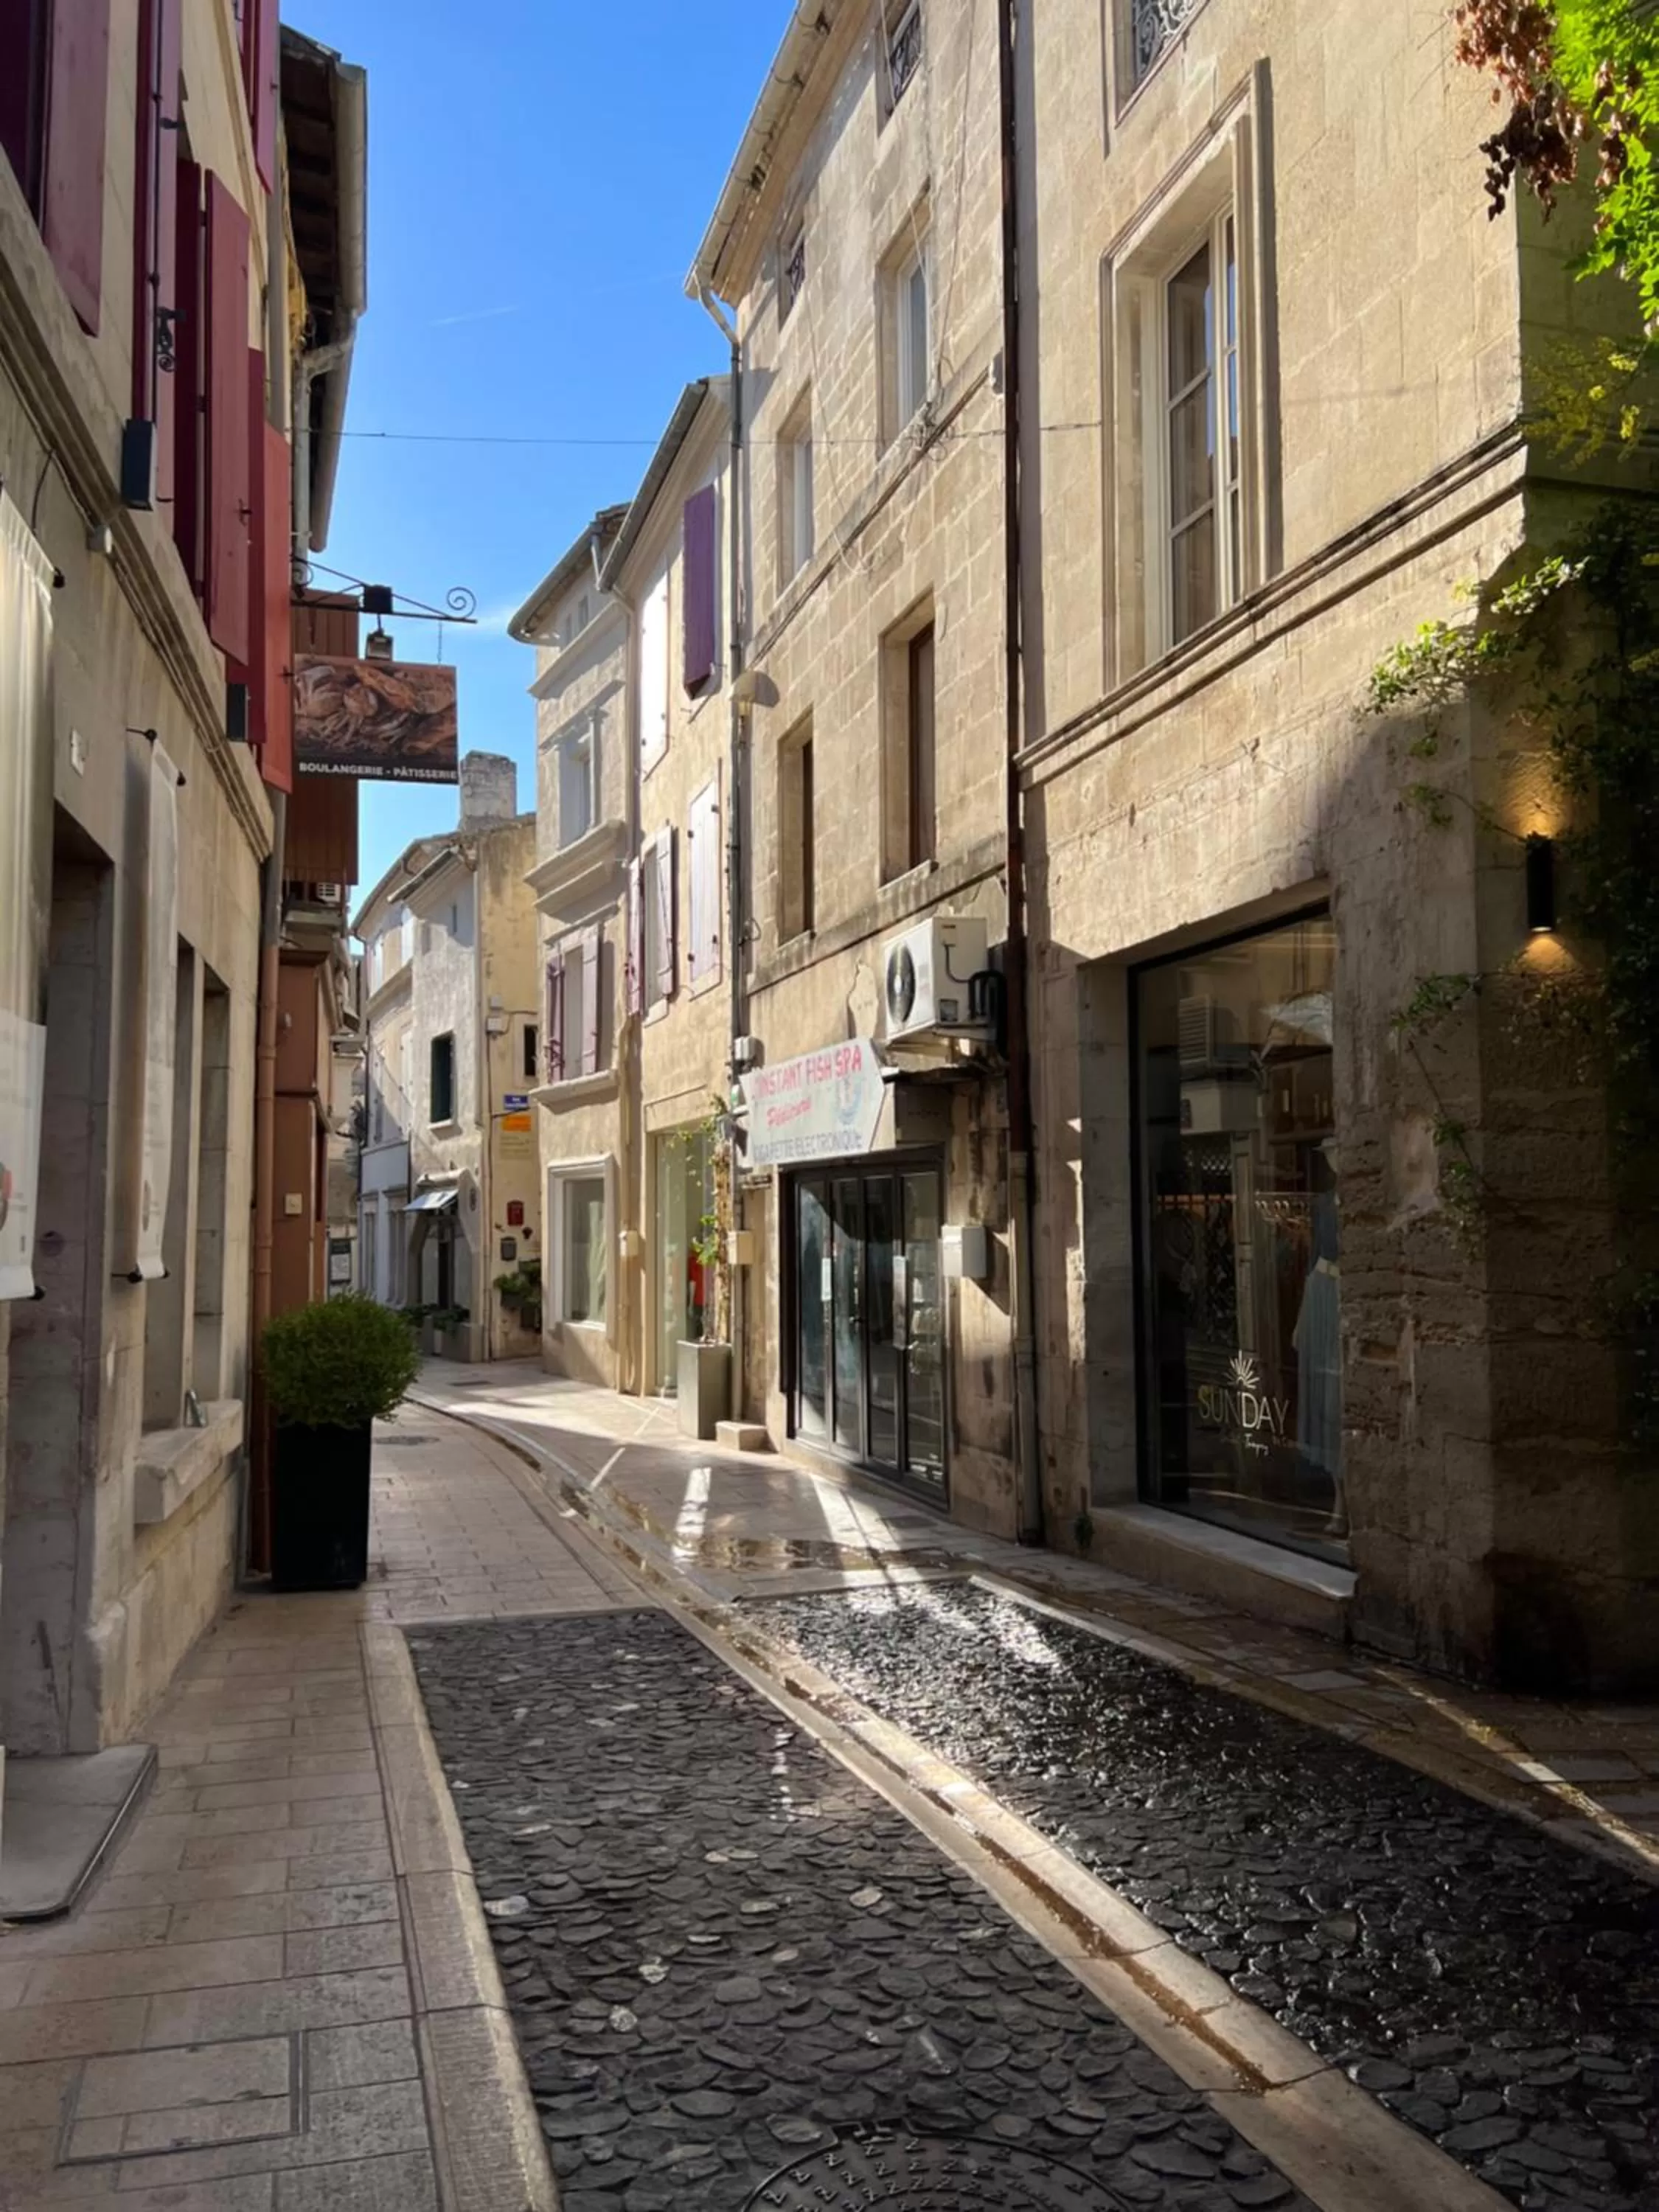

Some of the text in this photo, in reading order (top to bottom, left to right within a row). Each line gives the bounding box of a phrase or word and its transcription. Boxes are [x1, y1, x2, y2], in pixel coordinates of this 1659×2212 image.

[299, 762, 383, 776] BOULANGERIE
[393, 766, 457, 779] PÂTISSERIE
[806, 1056, 832, 1087] FISH
[835, 1044, 862, 1078] SPA
[1197, 1384, 1290, 1435] SUNDAY
